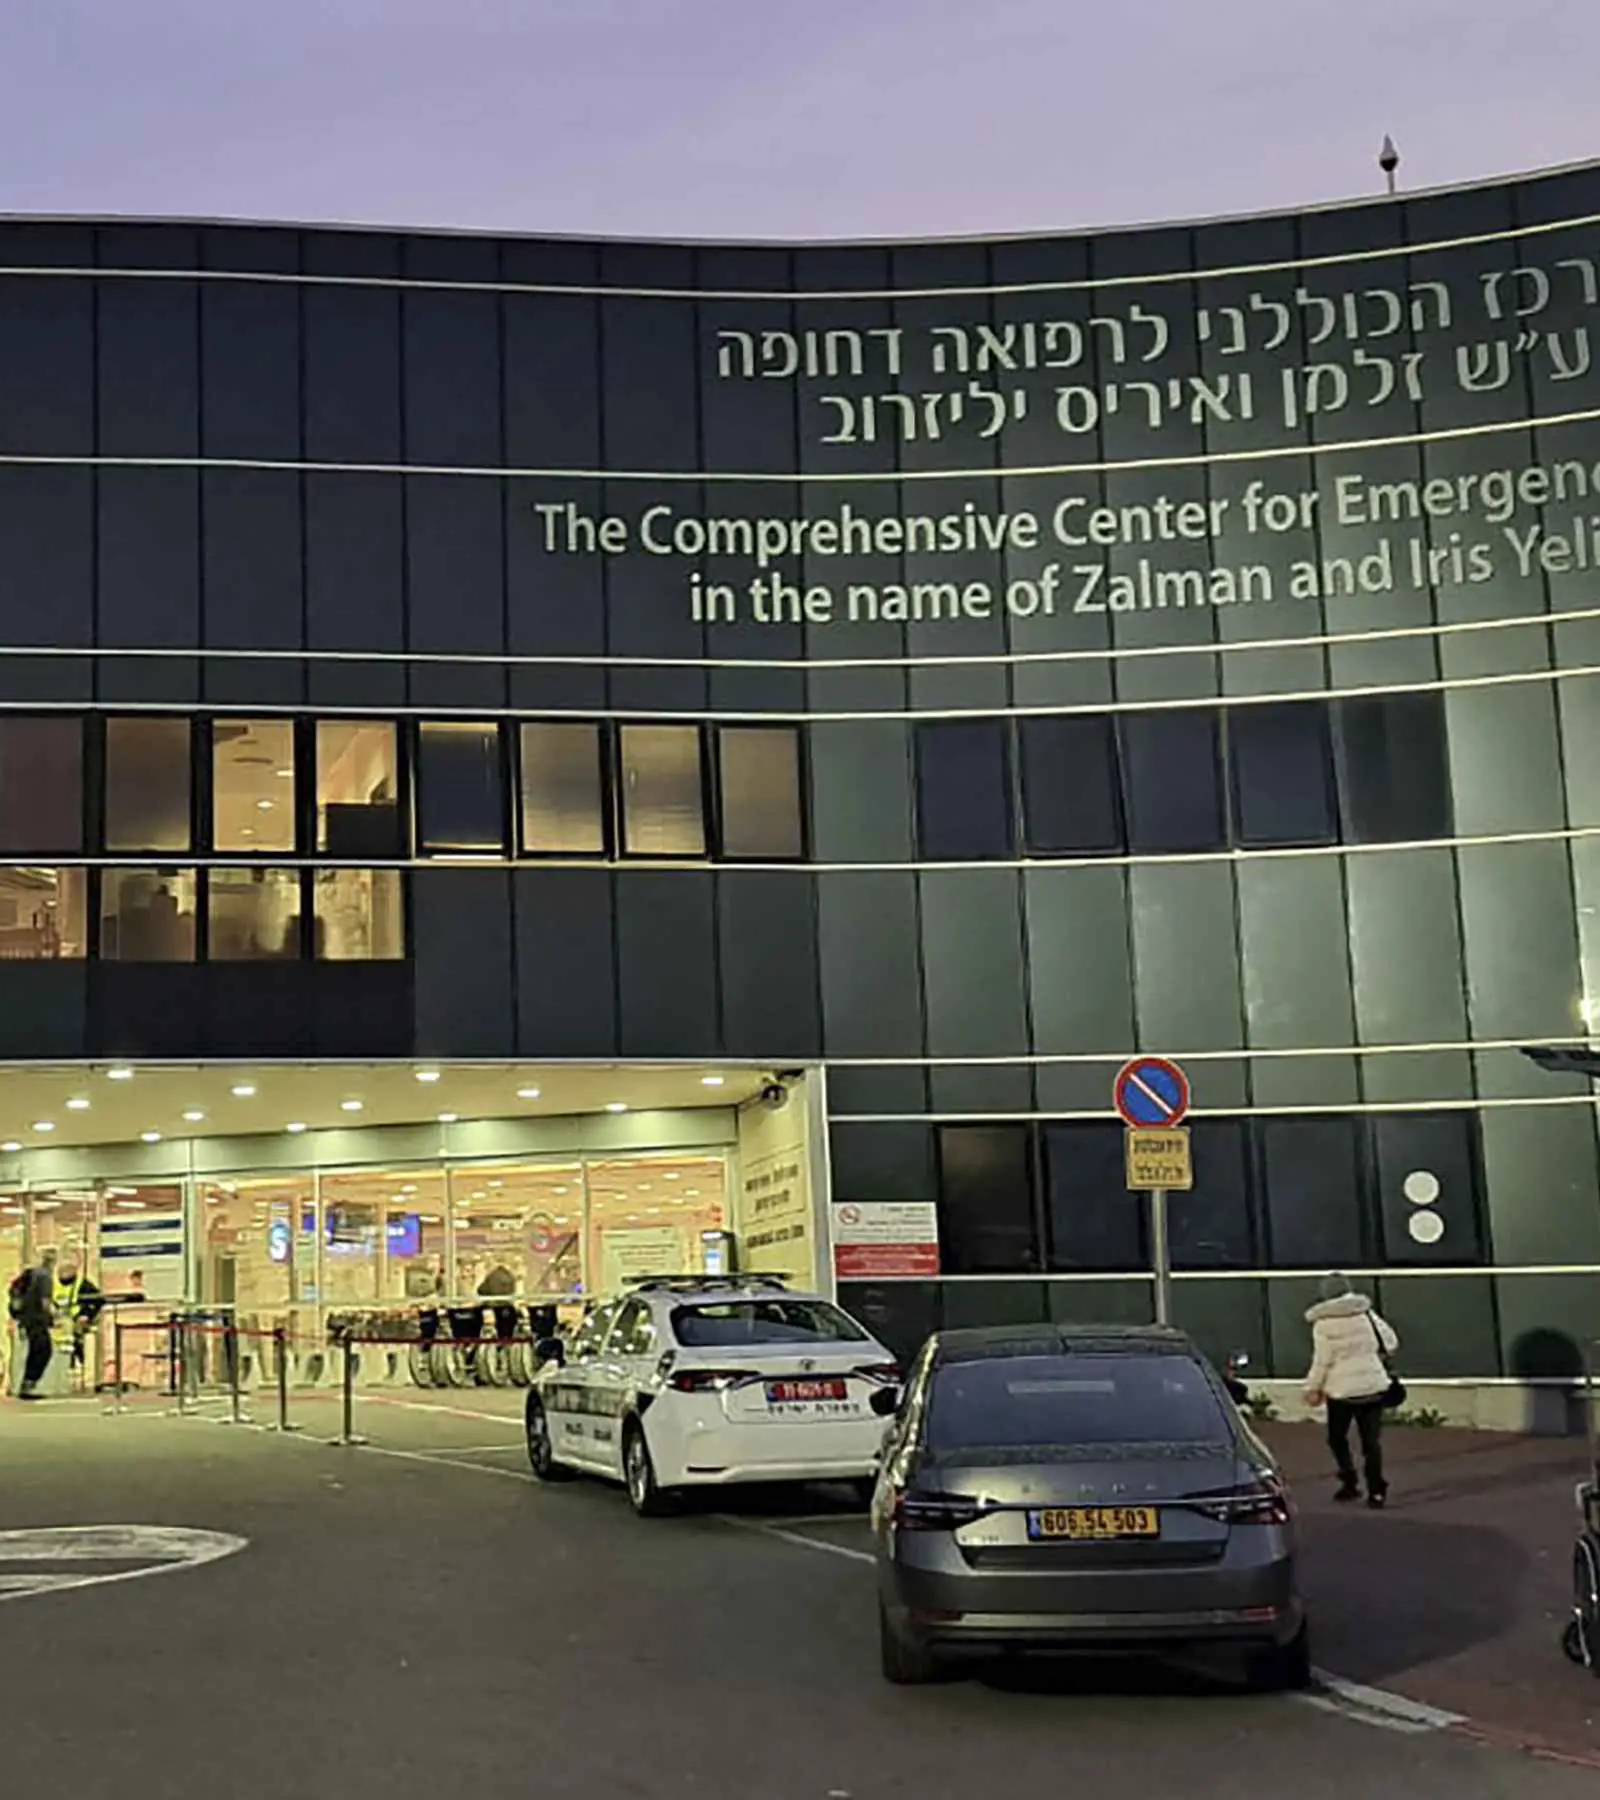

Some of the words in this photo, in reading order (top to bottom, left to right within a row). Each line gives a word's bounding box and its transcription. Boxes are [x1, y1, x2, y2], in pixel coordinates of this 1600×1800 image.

[716, 327, 905, 378] דחופה
[930, 306, 1169, 374] לרפואה
[1197, 280, 1451, 355] הכוללני
[819, 379, 1027, 443] יליזרוב
[1055, 372, 1253, 434] ואיריס
[1281, 350, 1425, 428] זלמן
[533, 501, 628, 553] The
[640, 502, 1039, 568] Comprehensive
[1052, 495, 1229, 547] Center
[1241, 480, 1320, 533] for
[690, 572, 736, 622] in
[748, 571, 833, 623] the
[847, 582, 992, 622] name
[1006, 563, 1060, 617] of
[1072, 558, 1272, 614] Zalman
[1290, 538, 1392, 599] and
[1409, 532, 1493, 588] Iris
